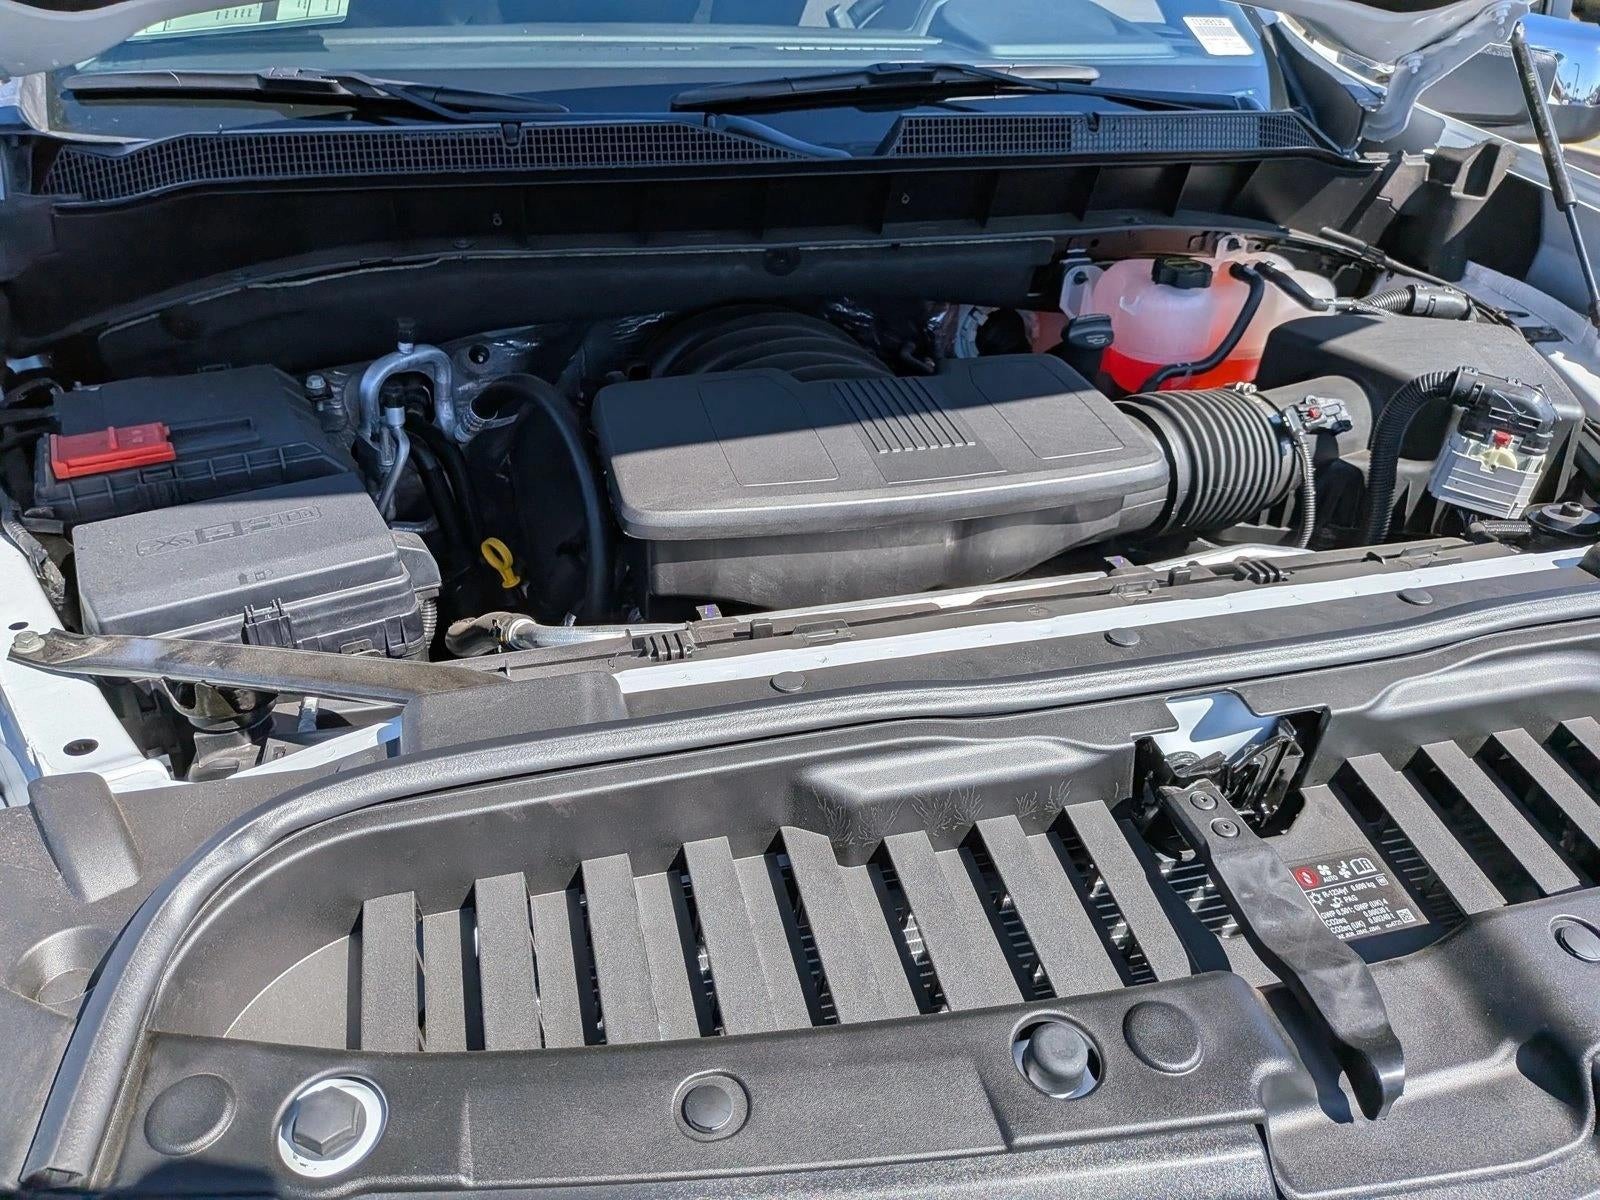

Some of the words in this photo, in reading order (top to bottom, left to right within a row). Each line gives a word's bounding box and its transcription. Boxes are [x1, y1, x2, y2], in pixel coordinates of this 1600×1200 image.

[1323, 875, 1338, 883] AUTO
[1321, 886, 1349, 898] R-1234yf
[1343, 894, 1358, 903] PAG
[1320, 909, 1336, 920] GWP
[1353, 902, 1369, 912] GWP
